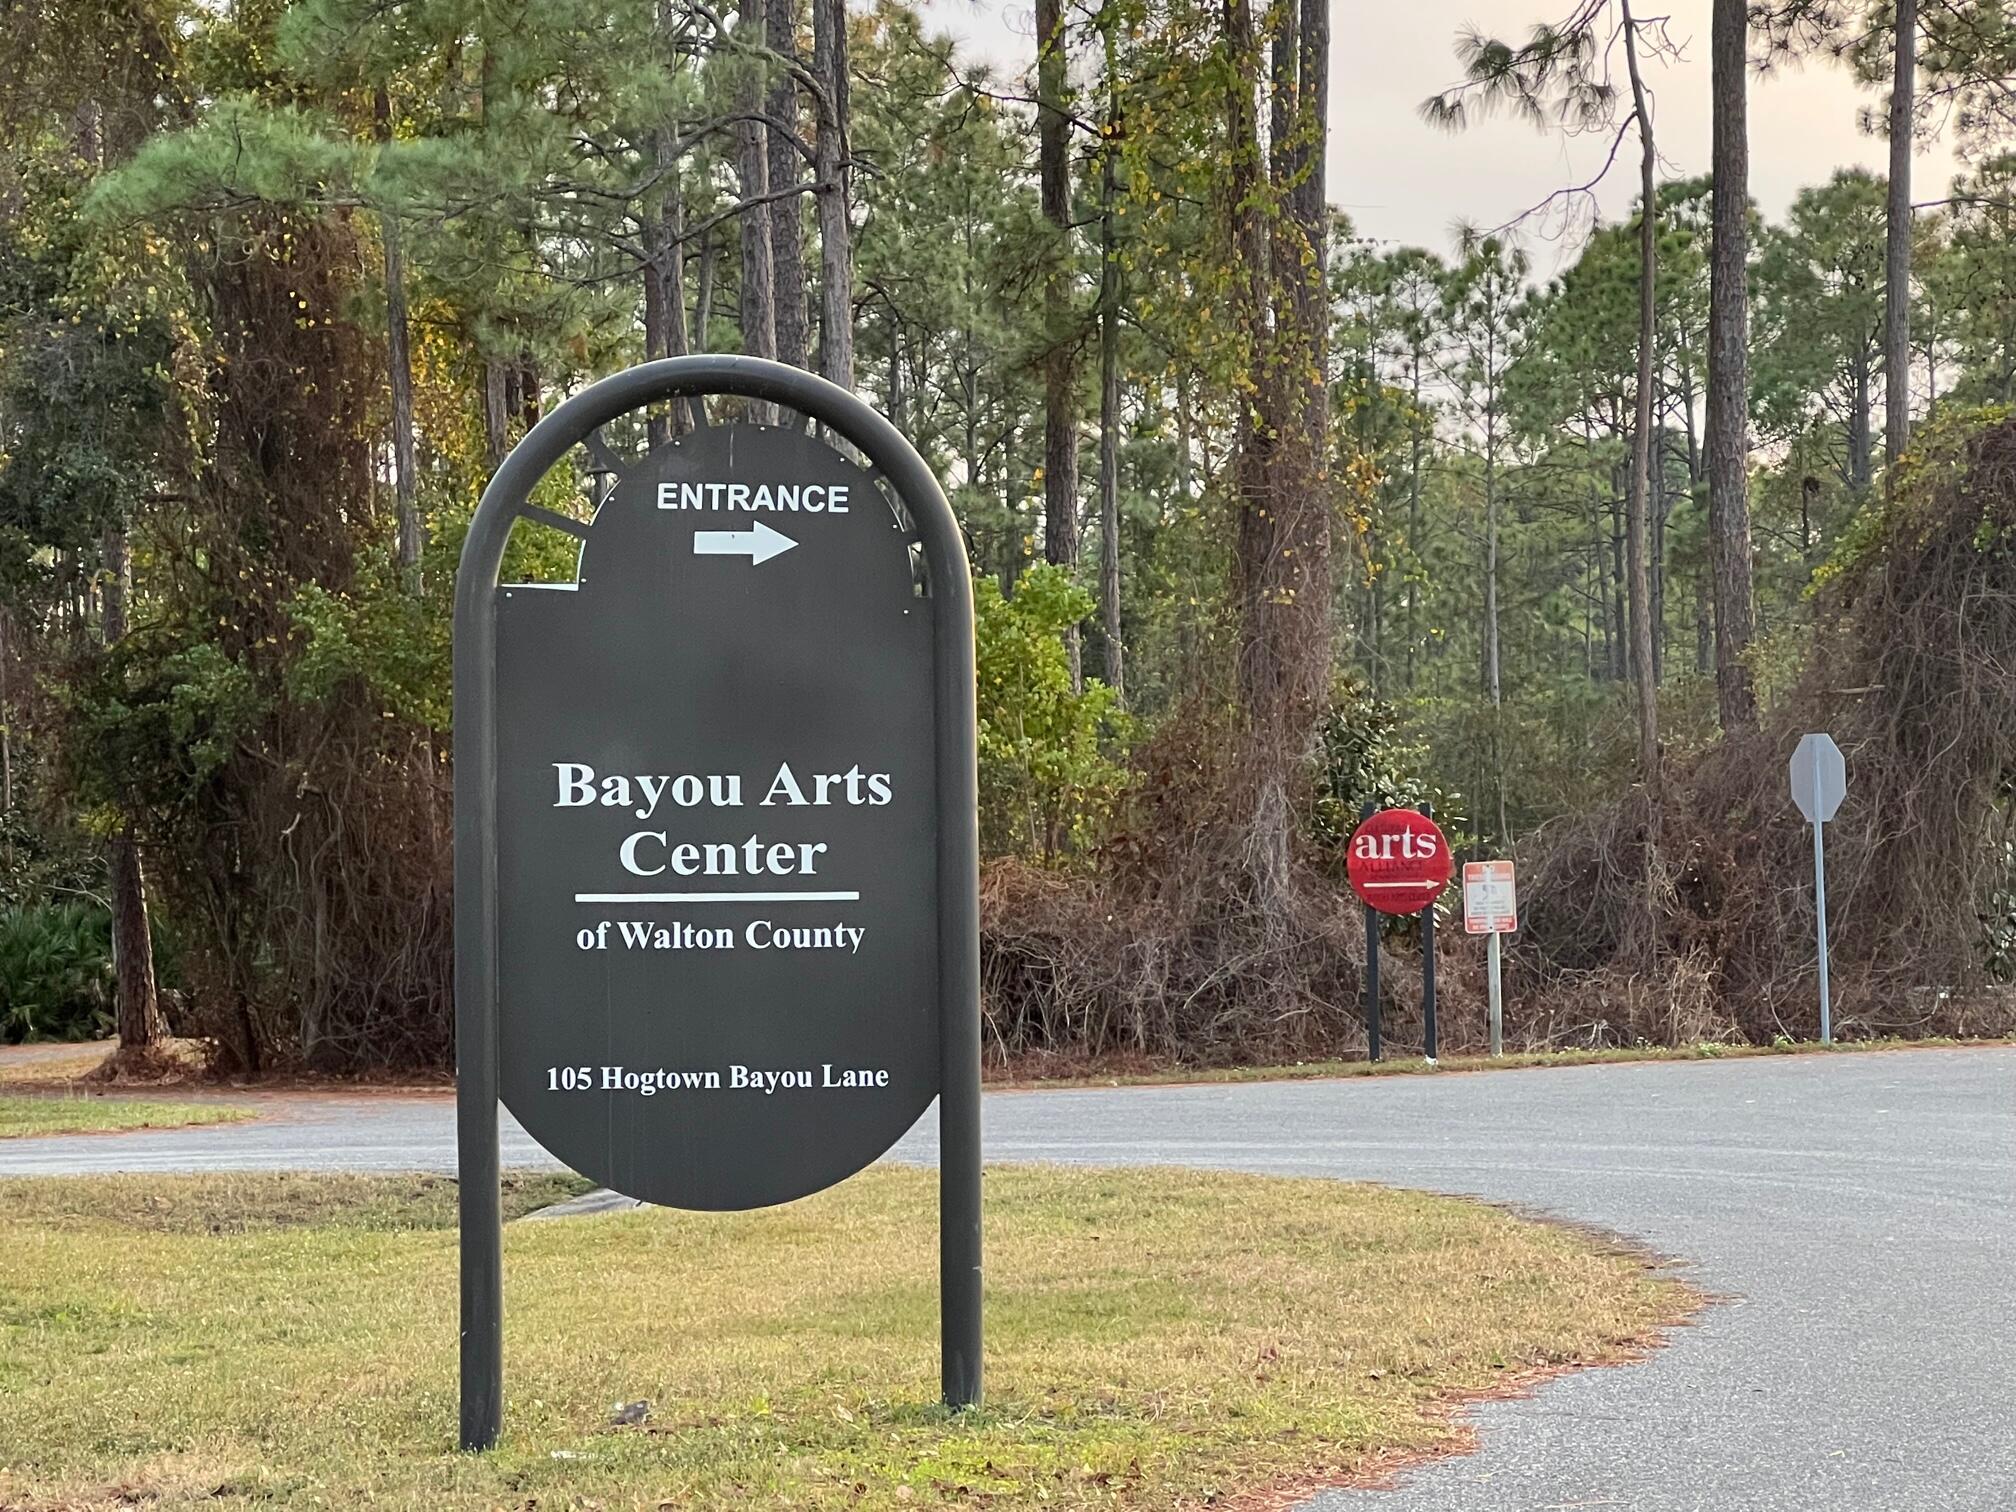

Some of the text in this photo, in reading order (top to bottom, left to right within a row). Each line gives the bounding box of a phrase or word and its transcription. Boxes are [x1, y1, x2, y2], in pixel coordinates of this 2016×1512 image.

[657, 482, 849, 513] ENTRANCE
[552, 761, 893, 819] Bayou Arts
[619, 831, 828, 876] Center
[1356, 824, 1436, 859] arts
[576, 920, 866, 955] of Walton County
[547, 1063, 889, 1096] 105 Hogtown Bayou Lane
